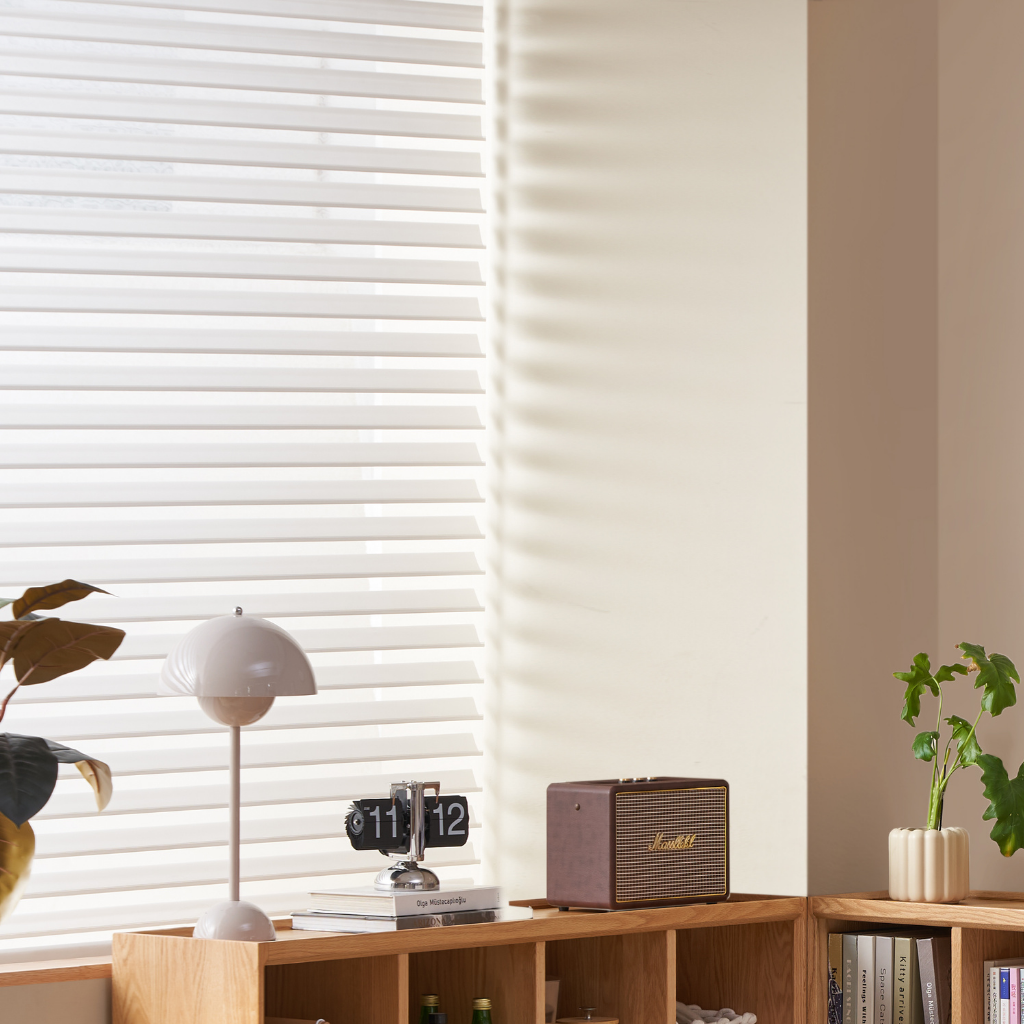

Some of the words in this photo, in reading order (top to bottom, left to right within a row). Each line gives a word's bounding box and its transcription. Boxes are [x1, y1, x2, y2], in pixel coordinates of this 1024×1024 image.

[369, 805, 397, 839] 11
[432, 802, 466, 836] 12
[416, 899, 429, 909] Olga
[897, 956, 907, 983] Kitty
[879, 968, 887, 1001] Space
[925, 982, 933, 998] Olga
